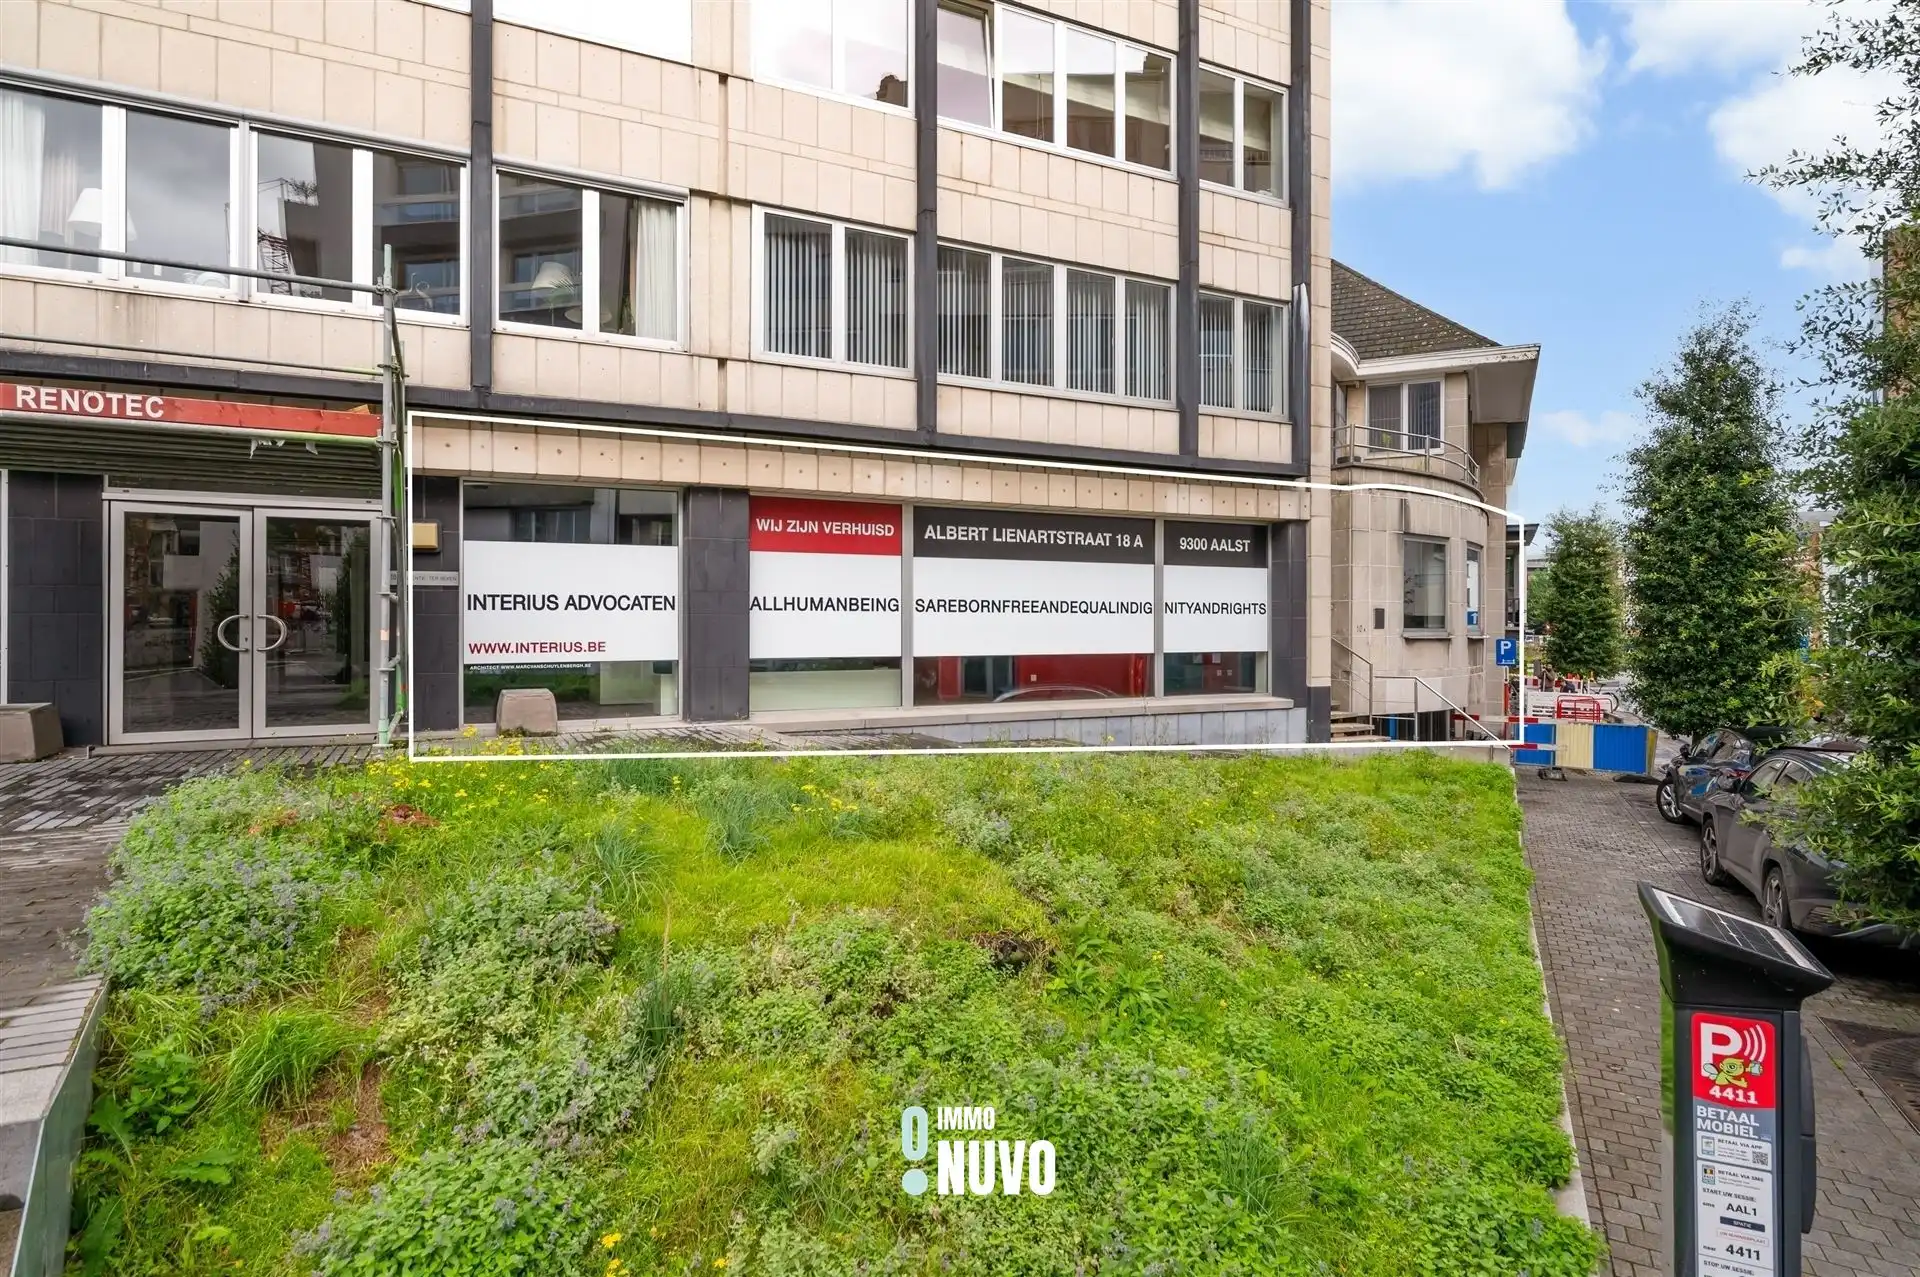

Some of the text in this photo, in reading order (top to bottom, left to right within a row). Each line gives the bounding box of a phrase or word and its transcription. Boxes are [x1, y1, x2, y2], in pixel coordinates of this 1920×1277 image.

[15, 385, 165, 419] RENOTEC
[755, 518, 895, 538] WIJ ZIJN VERHUISD
[924, 524, 1144, 548] ALBERT LIENARTSTRAAT 18 A
[1179, 536, 1251, 553] 9300 AALST
[467, 593, 676, 612] INTERIUS ADVOCATEN
[750, 595, 900, 613] ALLHUMANBEING
[914, 598, 1153, 615] SAREBORNFREEANDEQUALINDIG
[1164, 602, 1267, 615] NITYANDRIGHTS
[468, 641, 607, 655] WWW.INTERIUS.BE
[1500, 640, 1512, 655] P
[1709, 1086, 1759, 1105] 4411
[1696, 1105, 1760, 1127] BETAAL
[1696, 1118, 1759, 1139] MOBIEL
[1717, 1138, 1739, 1147] BETAAL
[1717, 1169, 1739, 1178] BETAAL
[1702, 1187, 1722, 1196] START
[1726, 1202, 1758, 1217] AAL1
[1732, 1220, 1752, 1229] SPATIE
[1725, 1243, 1761, 1261] 4411
[1703, 1260, 1720, 1268] STOP
